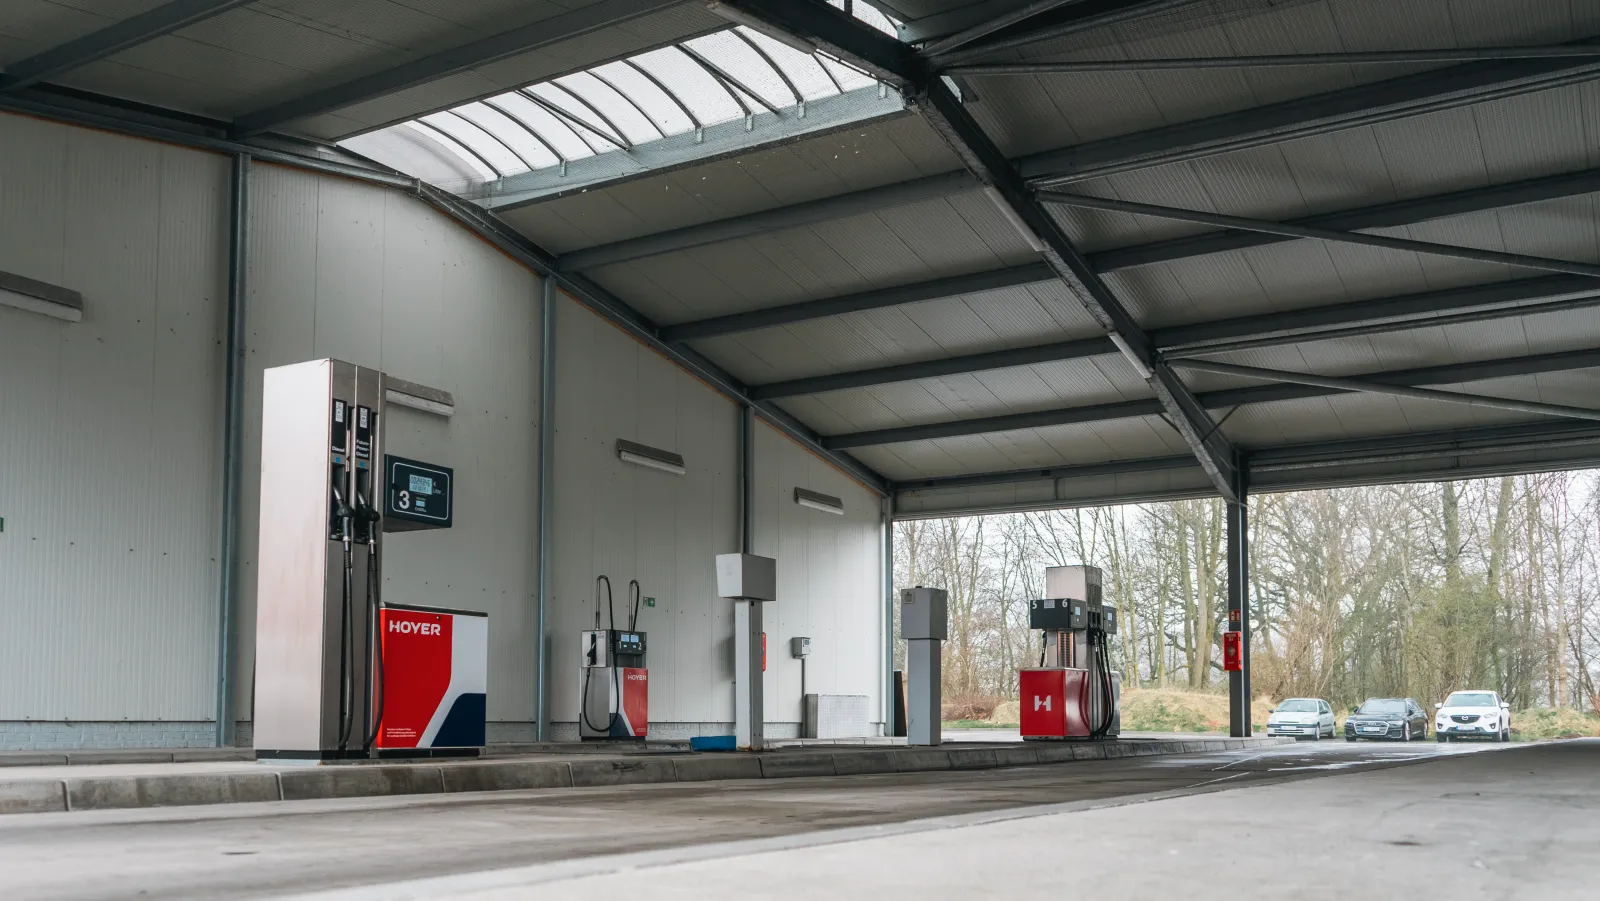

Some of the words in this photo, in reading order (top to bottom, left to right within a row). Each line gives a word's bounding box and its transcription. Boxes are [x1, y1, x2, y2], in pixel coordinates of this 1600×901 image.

[332, 445, 345, 453] Diesel
[399, 490, 410, 509] 3
[1032, 600, 1038, 610] 5
[1062, 598, 1068, 608] 6
[389, 619, 441, 636] HOYER
[638, 642, 642, 651] 2
